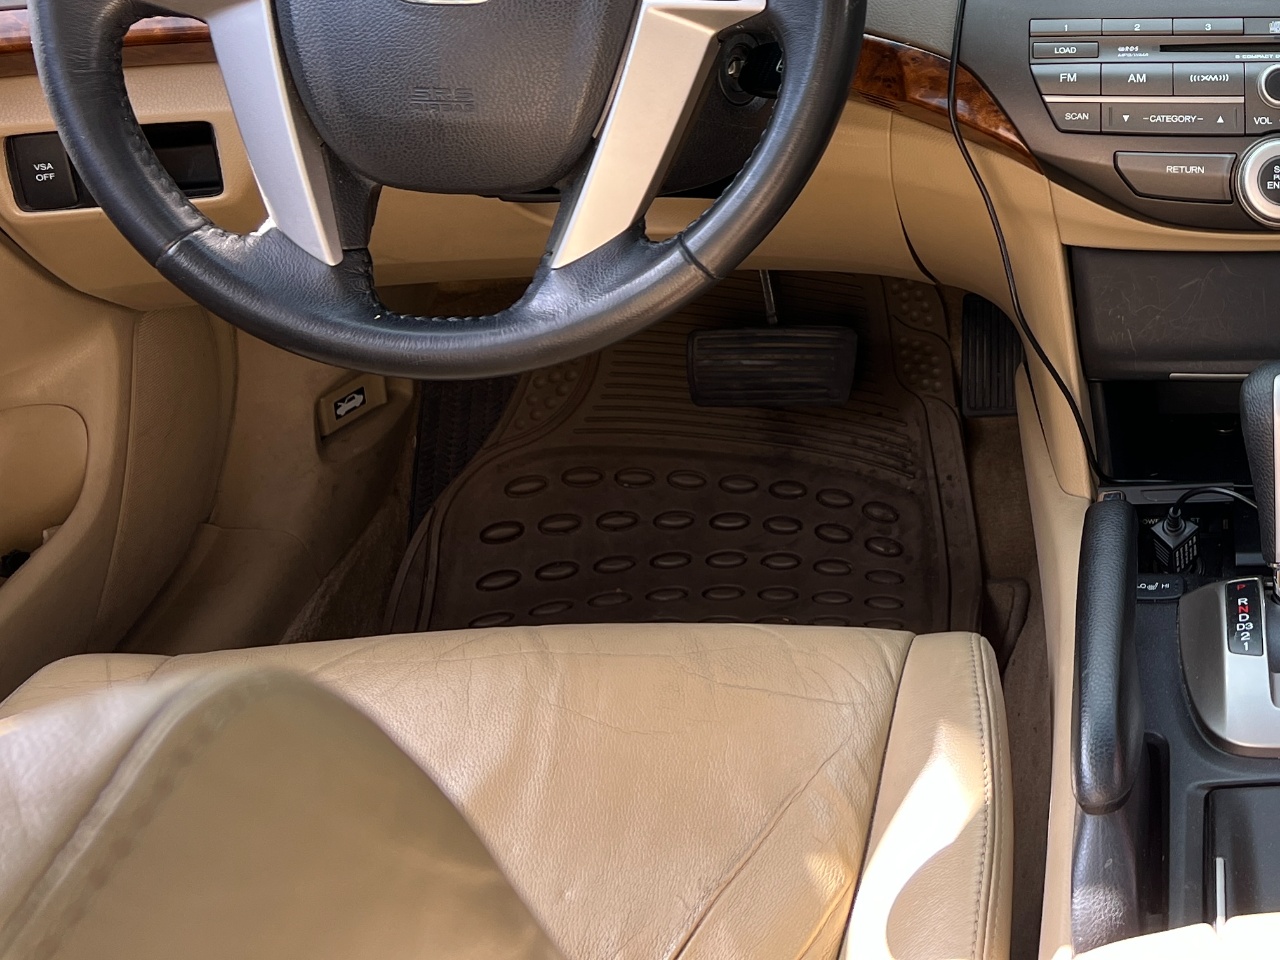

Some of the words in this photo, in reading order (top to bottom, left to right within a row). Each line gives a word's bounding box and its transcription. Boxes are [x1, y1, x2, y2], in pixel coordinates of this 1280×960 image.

[1060, 73, 1077, 82] FM
[1128, 74, 1146, 83] AM
[1254, 117, 1272, 125] VOL
[34, 163, 54, 171] VSA
[1166, 166, 1204, 174] RETURN
[36, 173, 55, 182] OFF
[1238, 598, 1248, 606] R
[1239, 614, 1250, 622] D
[1237, 622, 1253, 631] D3
[1241, 632, 1250, 641] 2
[1244, 642, 1248, 651] 1
